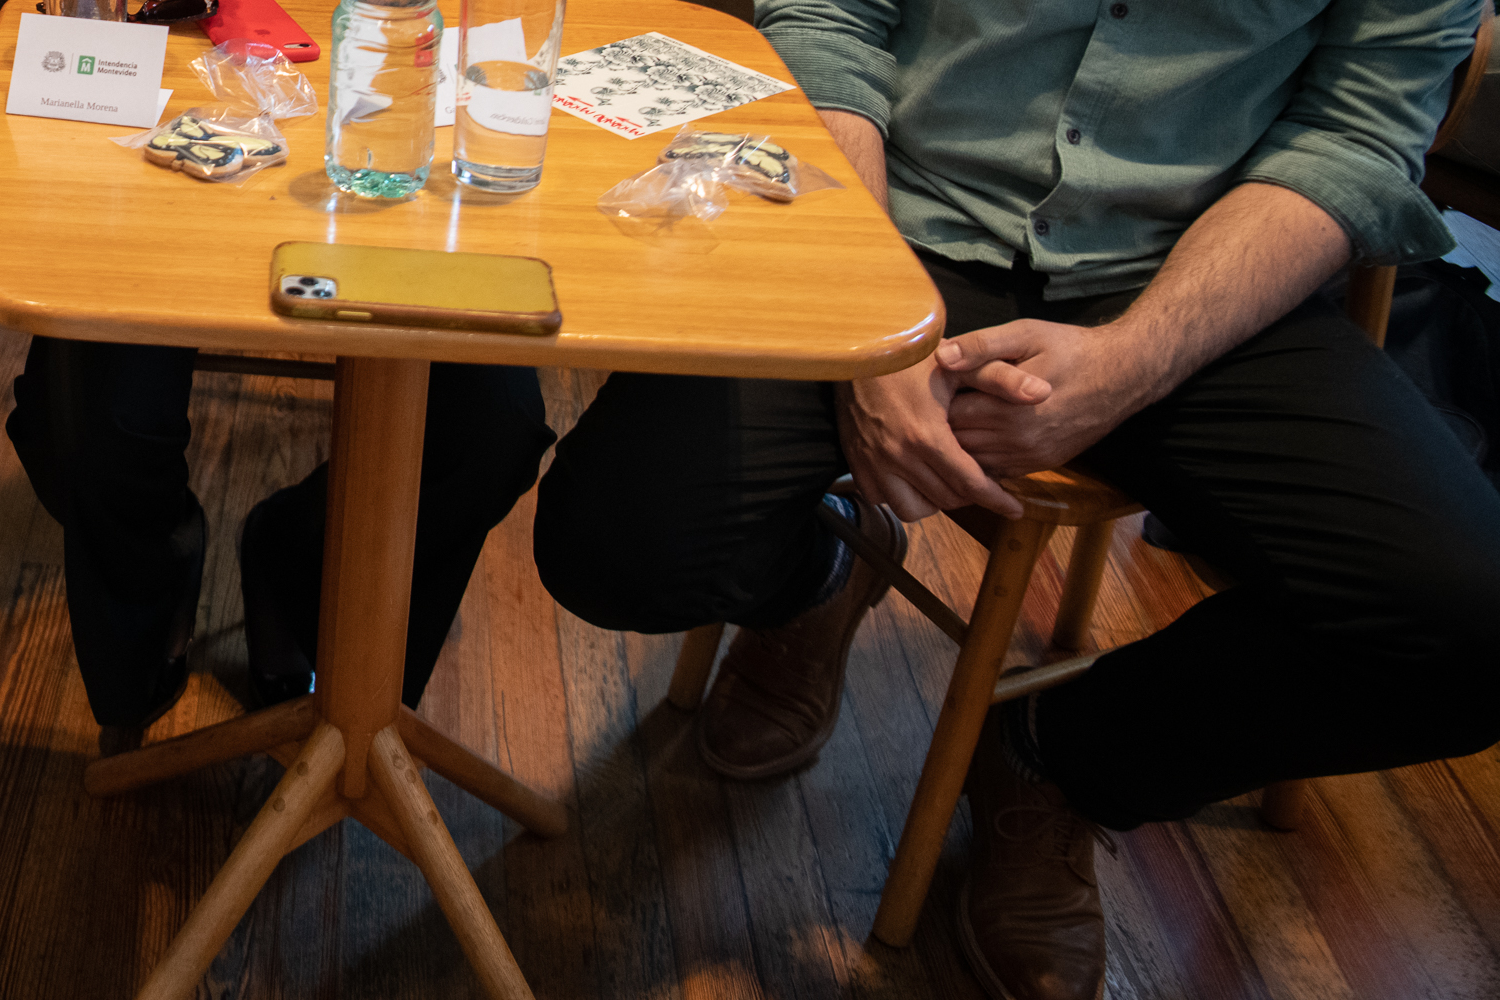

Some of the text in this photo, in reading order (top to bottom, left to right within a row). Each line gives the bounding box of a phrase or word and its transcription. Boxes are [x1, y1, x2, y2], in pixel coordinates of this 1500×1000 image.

[98, 59, 138, 69] Intendencia
[97, 67, 137, 77] Montevideo
[40, 97, 118, 113] Marianella Morena
